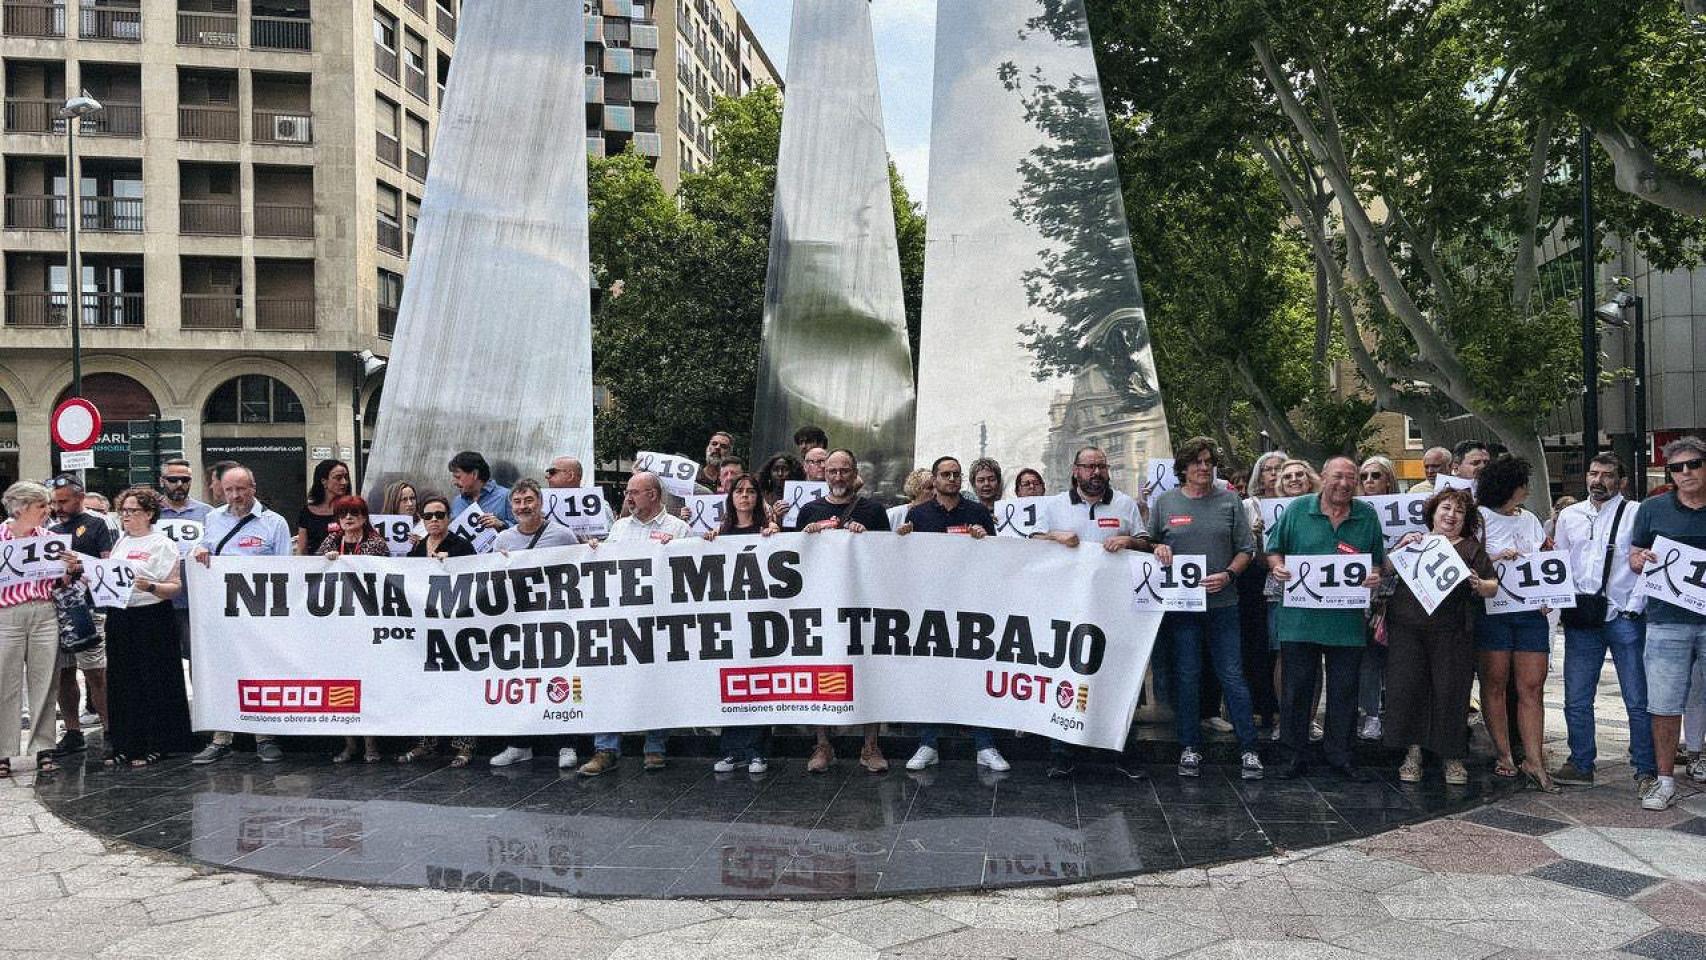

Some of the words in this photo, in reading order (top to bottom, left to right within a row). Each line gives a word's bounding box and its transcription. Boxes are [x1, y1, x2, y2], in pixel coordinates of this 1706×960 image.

[659, 459, 695, 481] 19
[565, 494, 602, 517] 19
[1385, 499, 1426, 526] 19
[162, 524, 200, 542] 19
[376, 521, 410, 543] 19
[457, 513, 485, 544] 19
[22, 540, 66, 564] 19
[224, 573, 290, 617] NI
[304, 572, 413, 617] UNA
[425, 558, 654, 619] MUERTE
[669, 545, 804, 603] MÁS
[1160, 563, 1202, 588] 19
[1320, 562, 1367, 587] 19
[1425, 552, 1460, 591] 19
[1516, 558, 1567, 588] 19
[1683, 559, 1706, 588] 1
[372, 627, 417, 644] por
[424, 612, 734, 671] ACCIDENTE
[747, 608, 823, 659] DE
[838, 608, 1107, 675] TRABAJO
[243, 686, 322, 706] CCOO
[484, 678, 542, 705] UGT
[727, 672, 812, 697] CCOO
[985, 670, 1052, 704] UGT
[239, 714, 282, 723] comisiones
[284, 714, 317, 723] obreras
[319, 714, 329, 722] de
[331, 714, 361, 725] Aragón
[543, 708, 583, 722] Aragón
[721, 703, 774, 713] comisiones
[776, 703, 809, 712] obreras
[810, 703, 821, 712] de
[822, 703, 854, 714] Aragón
[1050, 712, 1085, 732] Aragón
